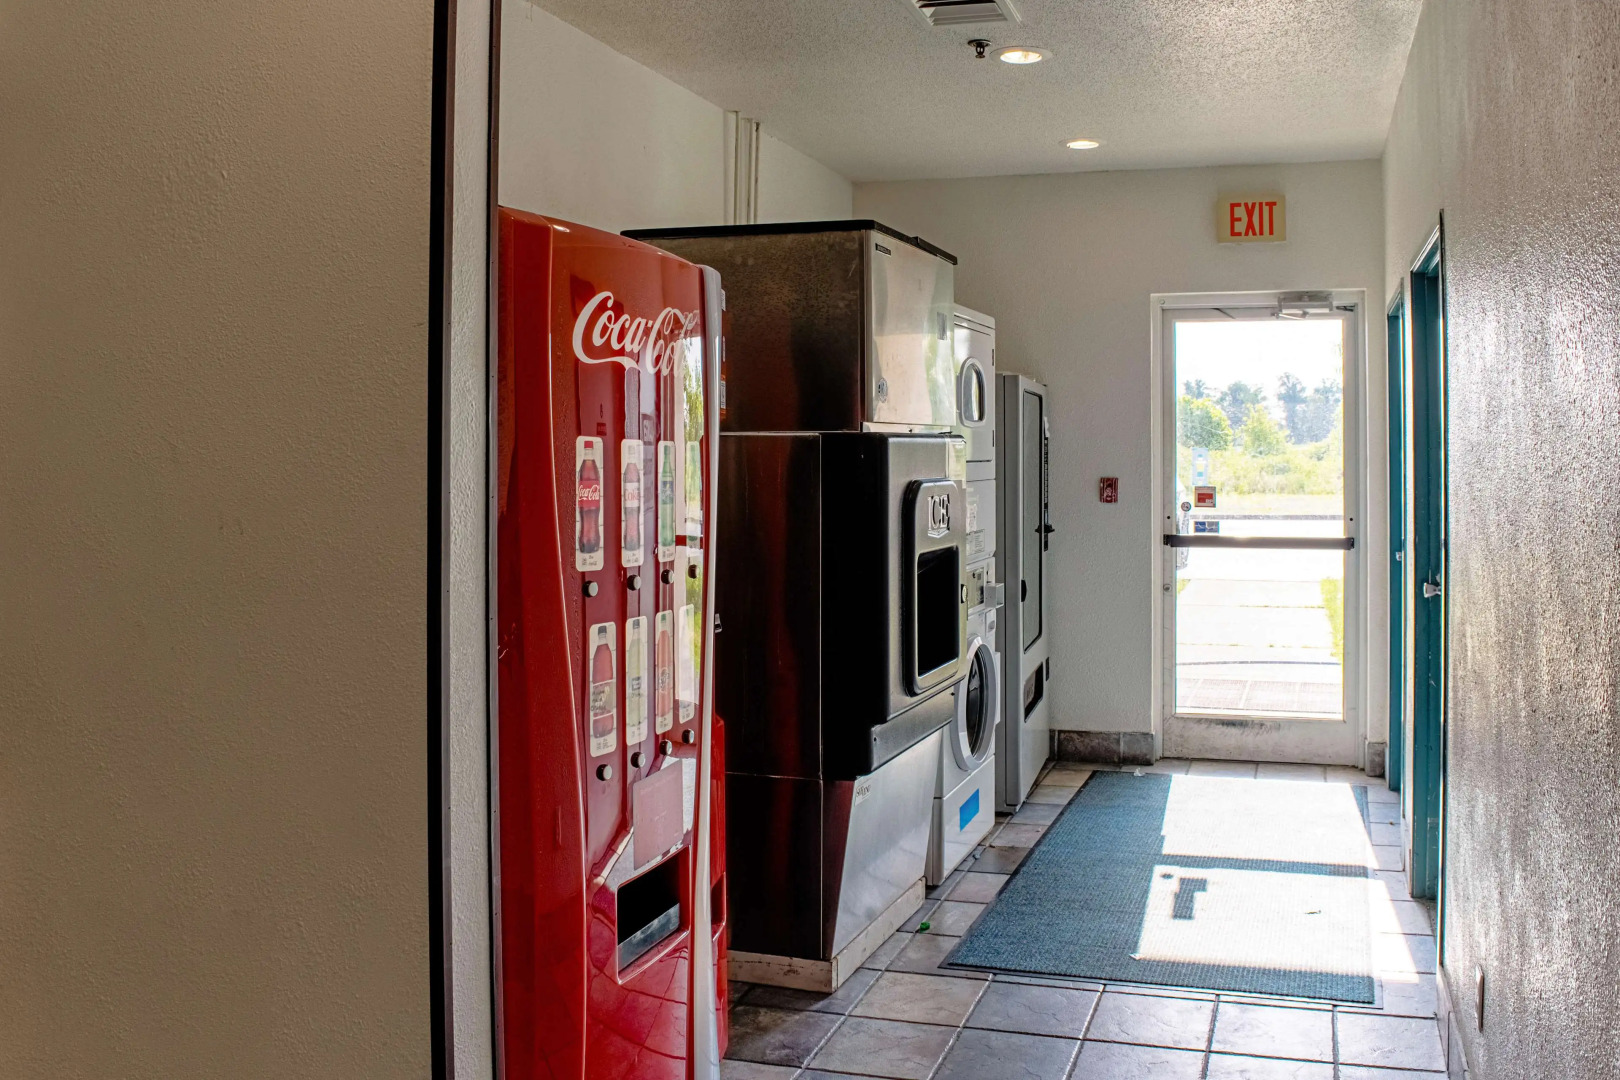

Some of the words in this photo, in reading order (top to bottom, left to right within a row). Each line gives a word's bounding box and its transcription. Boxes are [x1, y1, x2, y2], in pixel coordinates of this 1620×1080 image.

[1230, 202, 1277, 236] EXIT
[572, 291, 699, 377] Coca-Col
[928, 494, 950, 530] ICE
